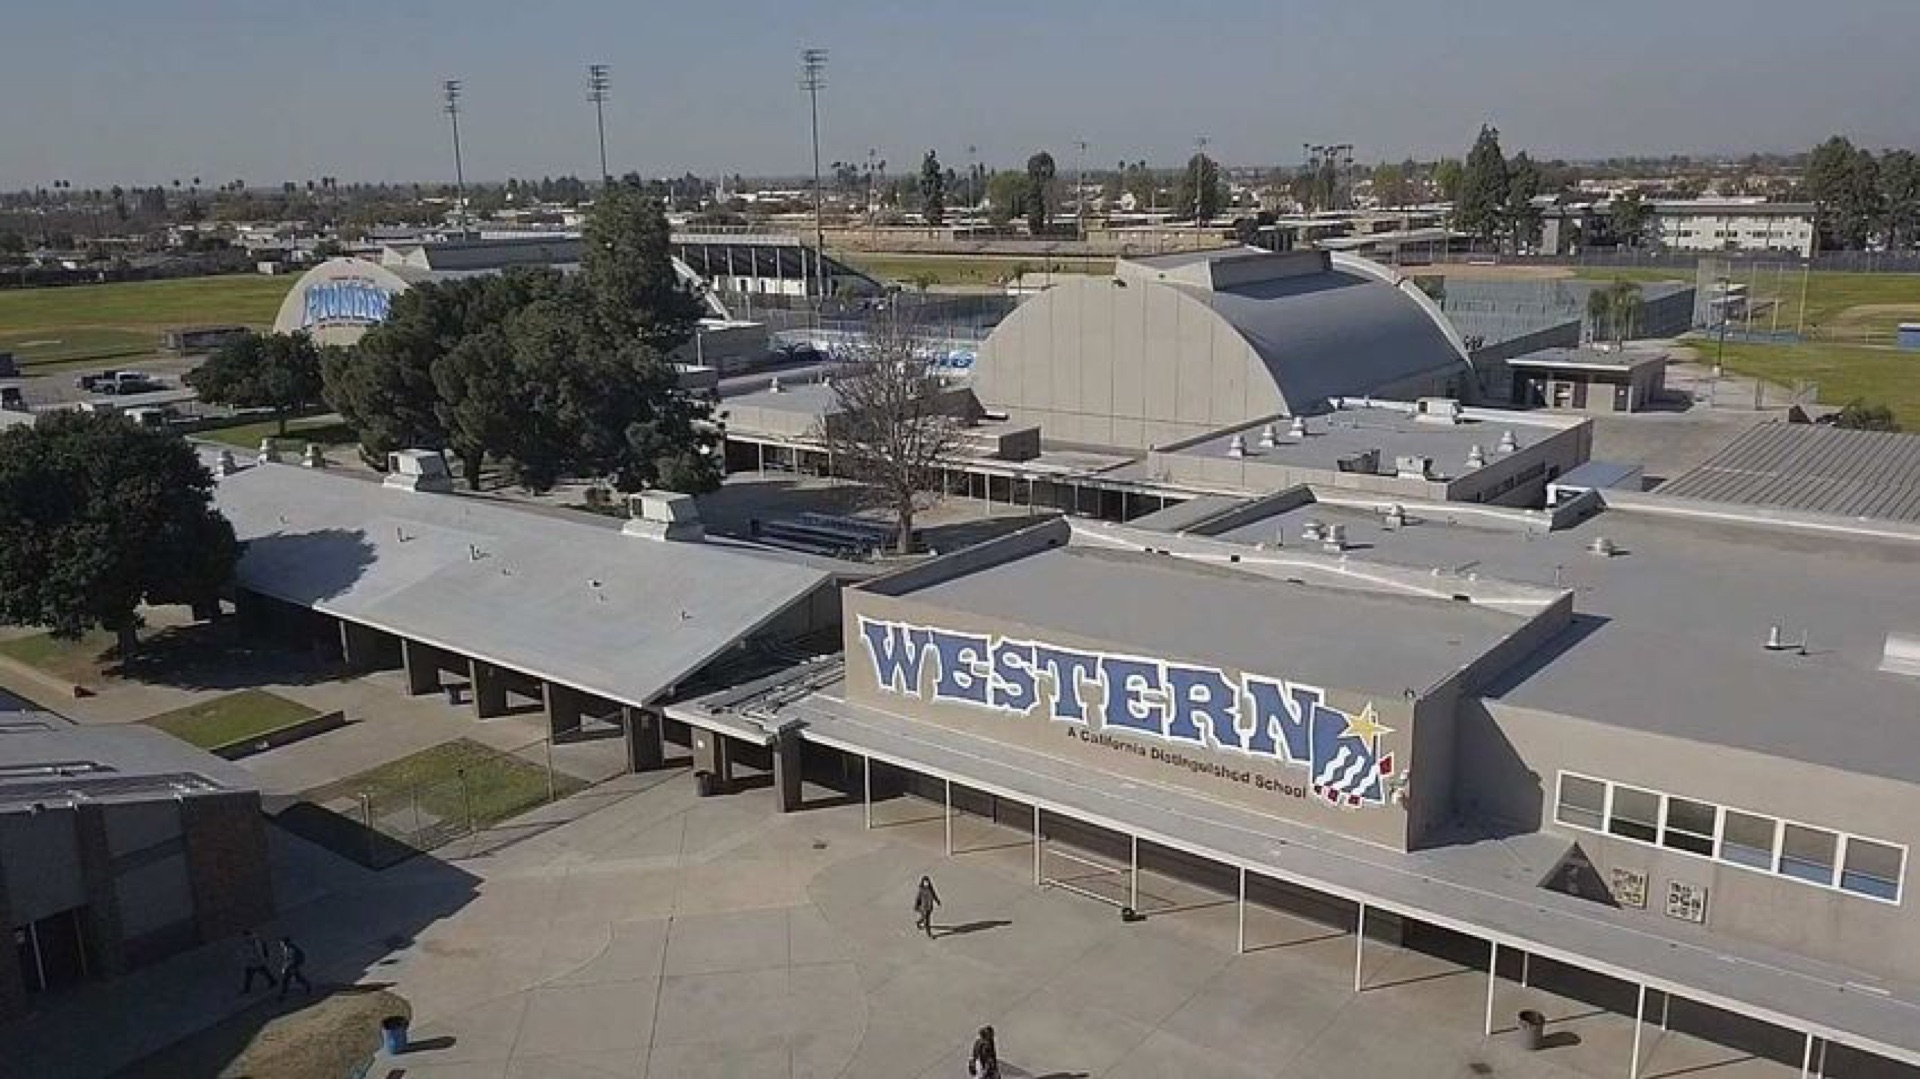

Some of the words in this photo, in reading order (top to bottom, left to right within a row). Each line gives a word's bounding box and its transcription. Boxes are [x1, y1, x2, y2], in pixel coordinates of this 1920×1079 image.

[857, 614, 1321, 763] WESTERN
[1068, 728, 1078, 738] A
[1081, 732, 1146, 756] California
[1151, 747, 1250, 784] Distinguished
[1255, 774, 1307, 799] School
